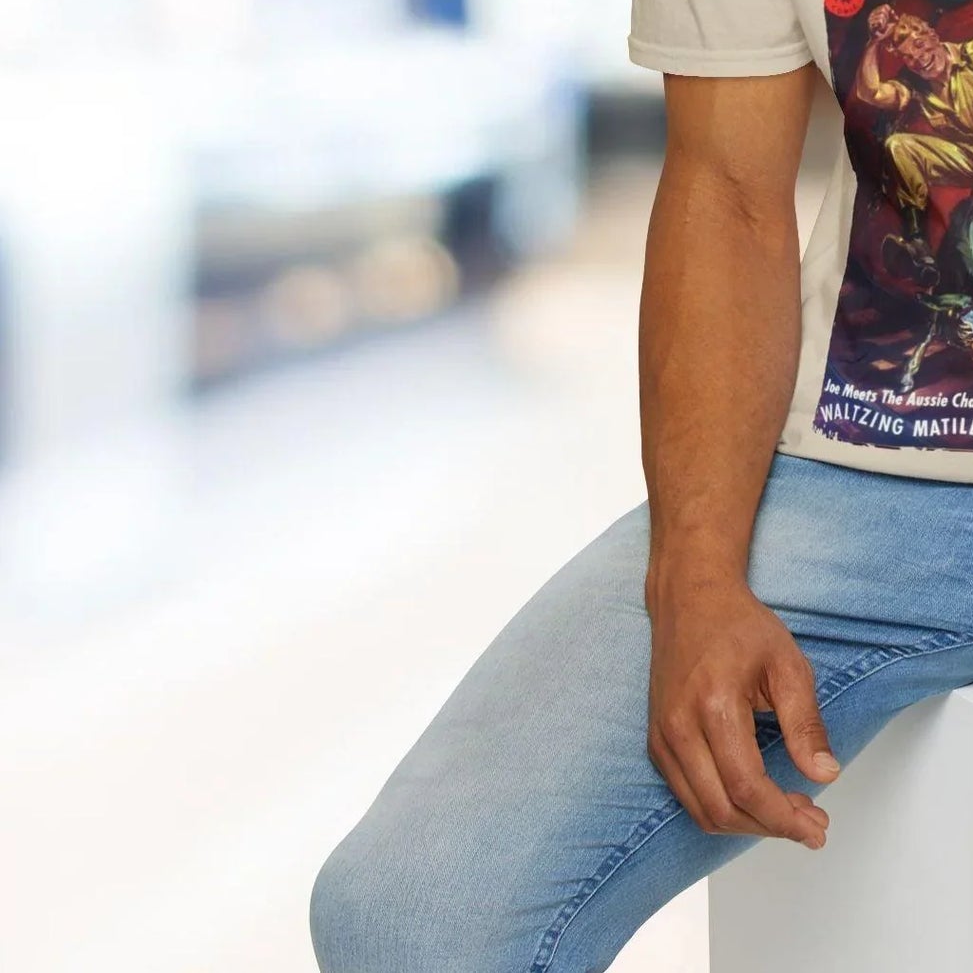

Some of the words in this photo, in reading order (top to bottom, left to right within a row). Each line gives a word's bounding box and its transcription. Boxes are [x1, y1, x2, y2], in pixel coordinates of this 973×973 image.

[824, 378, 840, 396] Joe
[841, 383, 878, 402] Meets
[881, 389, 903, 406] The
[905, 392, 949, 408] Aussie
[819, 401, 905, 436] WALTZING
